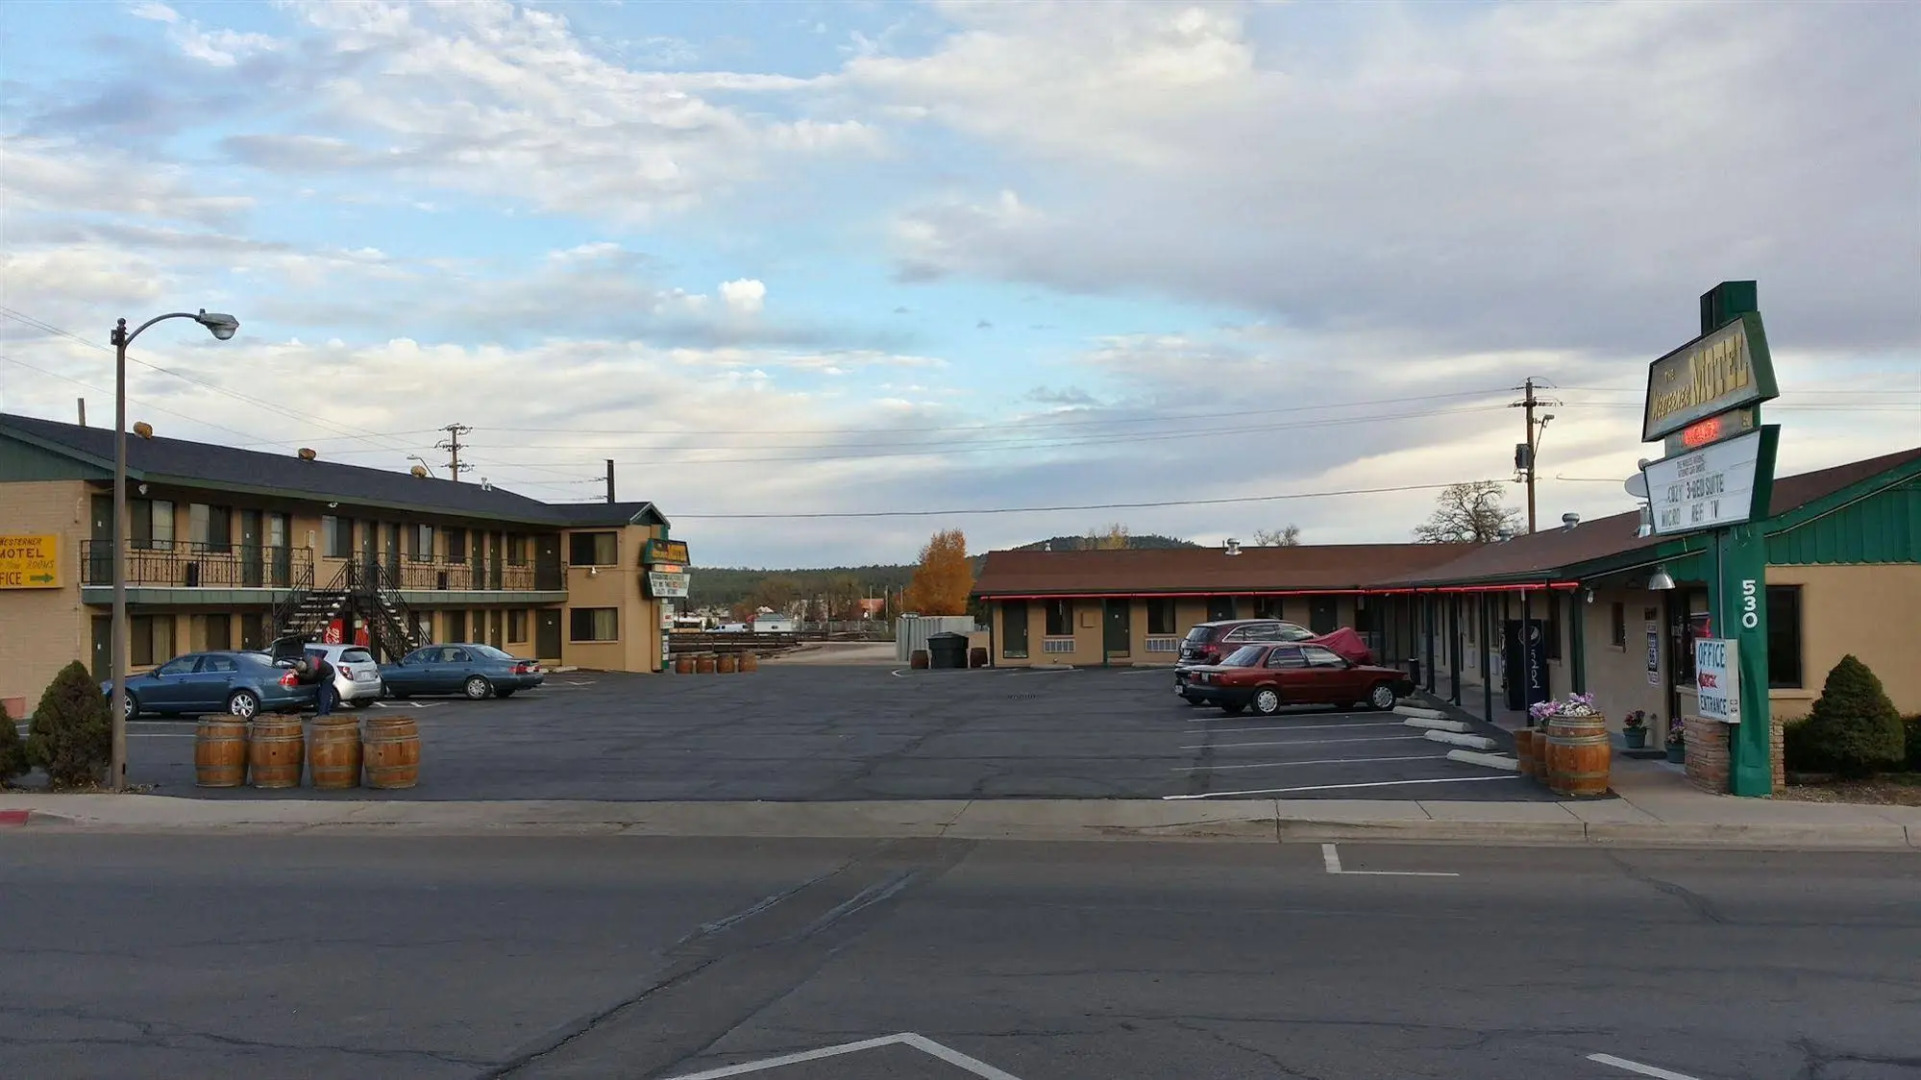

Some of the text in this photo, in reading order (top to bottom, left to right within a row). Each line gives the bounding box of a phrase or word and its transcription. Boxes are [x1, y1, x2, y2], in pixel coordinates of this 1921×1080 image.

[1690, 333, 1749, 406] MOTEL
[1705, 474, 1725, 497] SUITE
[1661, 499, 1719, 527] MICRO REF TV
[1742, 579, 1758, 628] 530
[1531, 648, 1541, 689] pepsi
[1698, 643, 1726, 668] OFFICE
[1700, 695, 1727, 716] ENTRANCE
